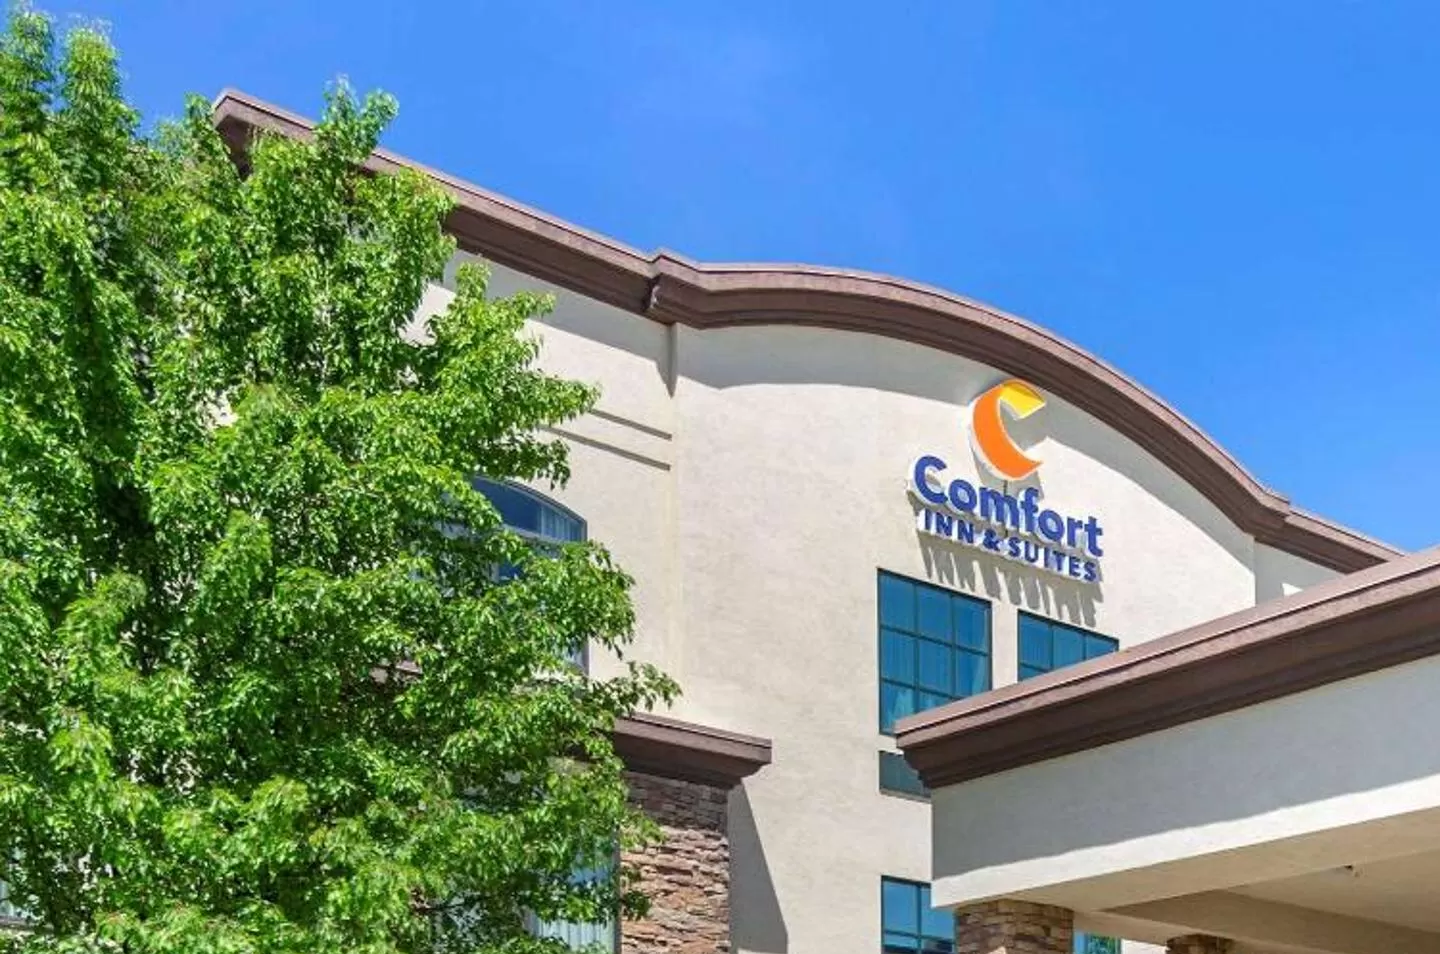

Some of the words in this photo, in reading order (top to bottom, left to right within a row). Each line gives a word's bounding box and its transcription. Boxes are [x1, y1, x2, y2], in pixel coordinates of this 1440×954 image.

[913, 454, 1104, 558] Comfort
[923, 507, 975, 544] INN
[1008, 535, 1097, 583] SUITES
